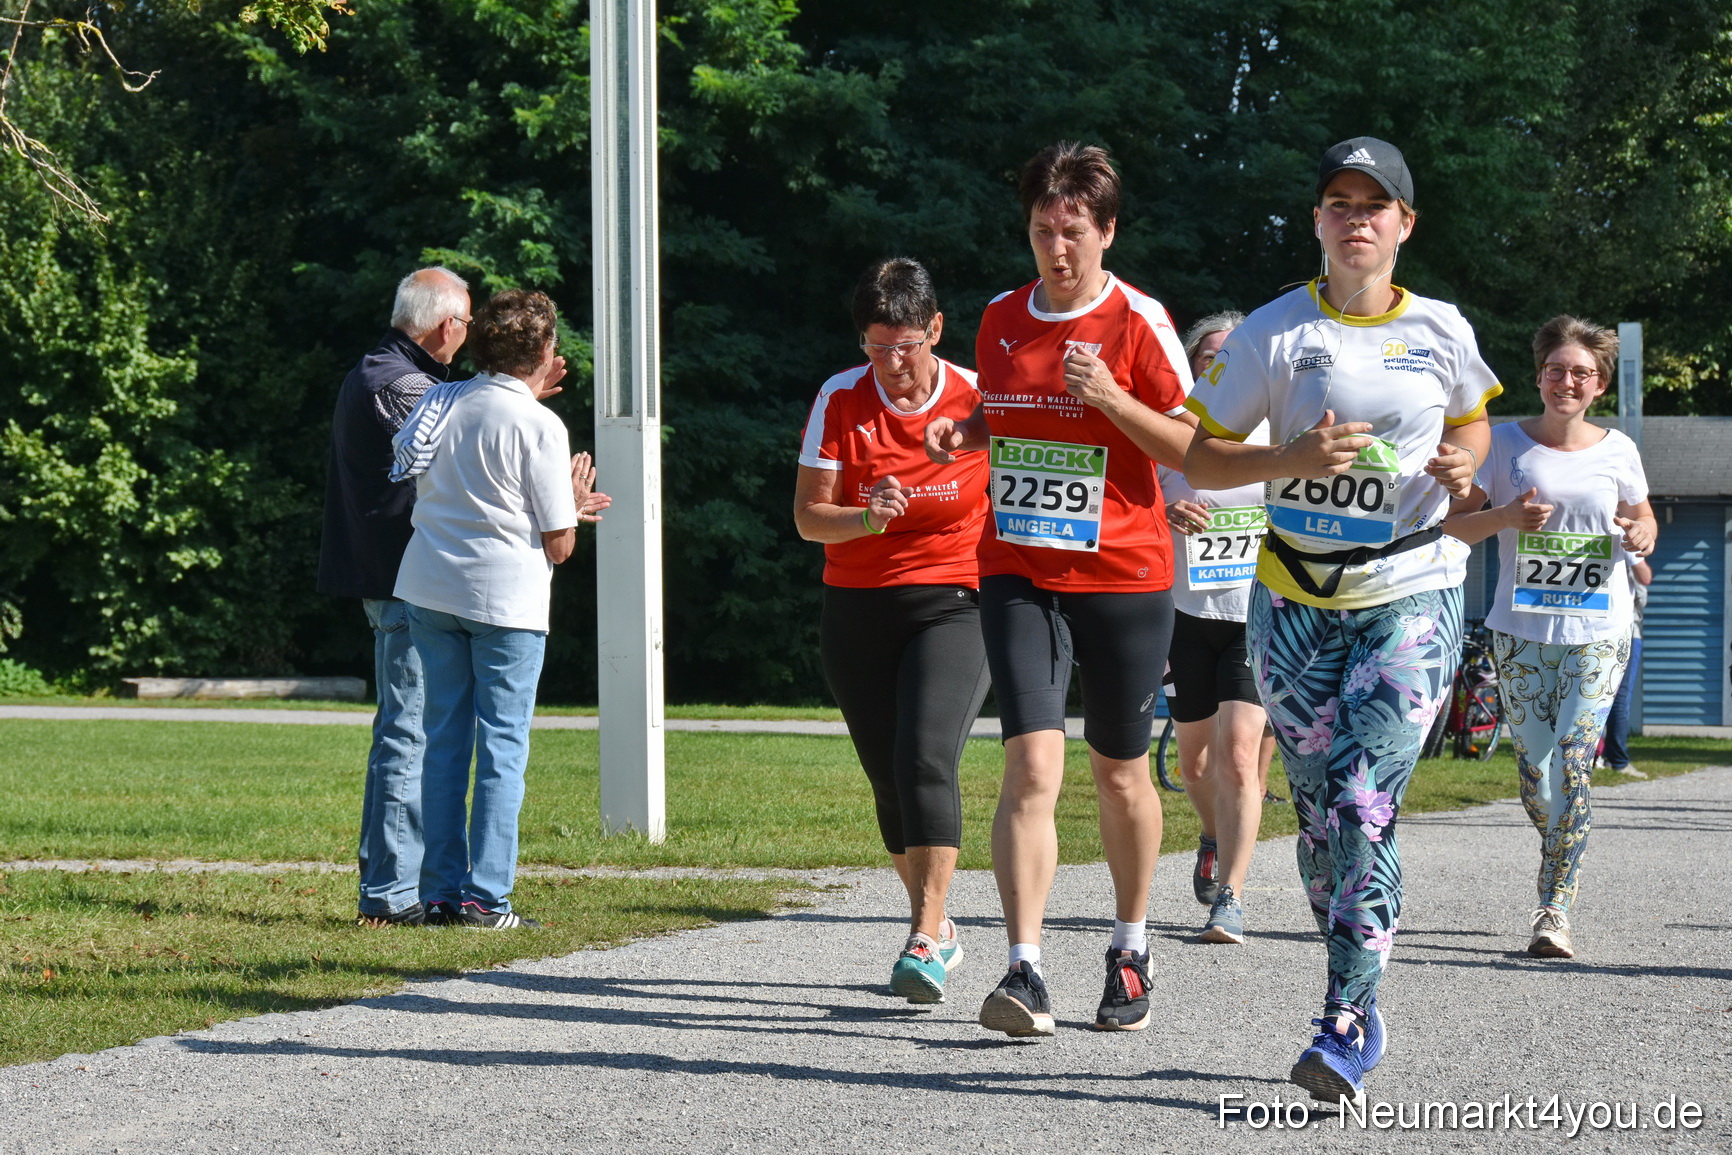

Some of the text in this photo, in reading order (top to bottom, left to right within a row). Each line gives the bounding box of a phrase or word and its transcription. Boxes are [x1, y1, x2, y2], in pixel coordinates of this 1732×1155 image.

[1343, 157, 1376, 166] adidas
[1384, 343, 1408, 356] 20
[1292, 355, 1332, 369] BOCK
[1037, 395, 1042, 403] &
[1059, 410, 1084, 419] Lauf
[998, 442, 1095, 473] BOCK
[925, 480, 959, 492] WALTER
[1280, 474, 1384, 512] 2600
[939, 493, 959, 502] Lauf
[1000, 475, 1089, 513] 2259
[1007, 518, 1075, 537] ANGELA
[1305, 516, 1342, 537] LEA
[1524, 533, 1605, 557] BOCK
[1526, 559, 1602, 588] 2276
[1542, 593, 1583, 606] RUTH
